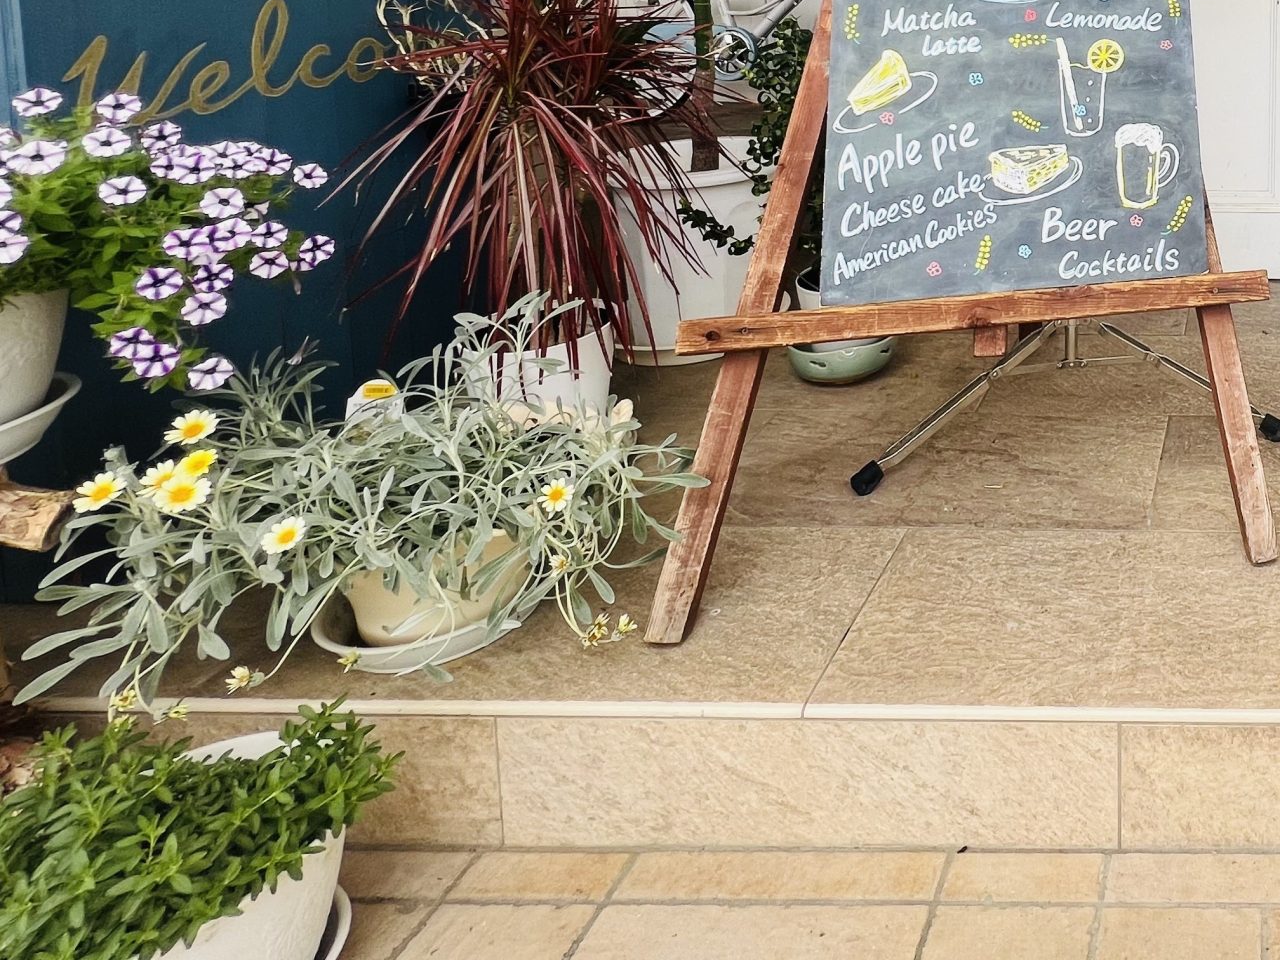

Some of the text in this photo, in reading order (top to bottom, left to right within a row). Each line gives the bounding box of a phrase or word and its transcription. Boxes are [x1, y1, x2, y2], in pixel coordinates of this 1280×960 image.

[881, 3, 977, 37] Matcha
[1045, 0, 1163, 32] Lemonade
[838, 122, 979, 194] Apple pie
[841, 171, 985, 238] Cheese cake
[1041, 206, 1118, 245] Beer
[833, 203, 998, 286] American Cookies
[1057, 238, 1180, 280] Cocktails
